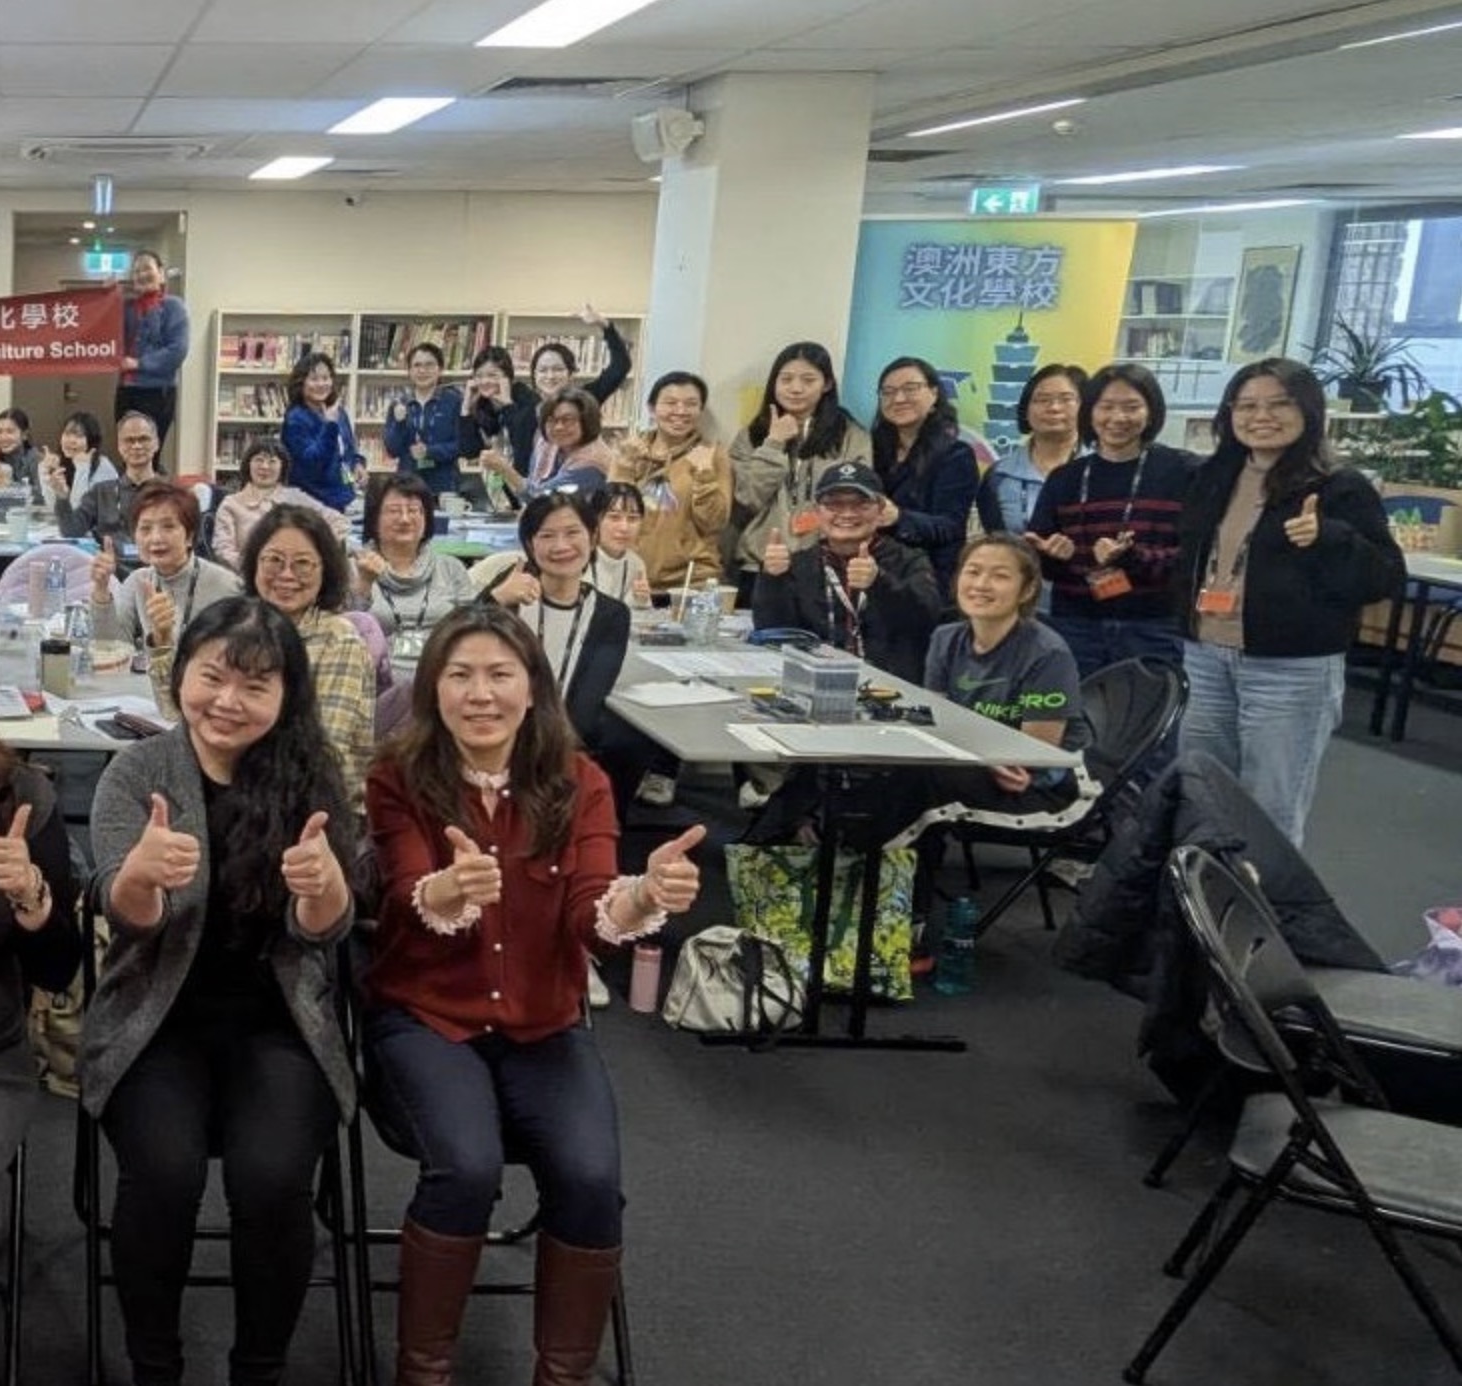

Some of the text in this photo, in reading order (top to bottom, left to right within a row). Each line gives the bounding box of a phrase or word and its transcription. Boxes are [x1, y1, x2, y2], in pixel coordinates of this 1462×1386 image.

[905, 245, 1063, 276] 澳洲東方
[902, 278, 1059, 309] 文化學校
[49, 339, 116, 358] School
[974, 701, 1024, 720] NIKE
